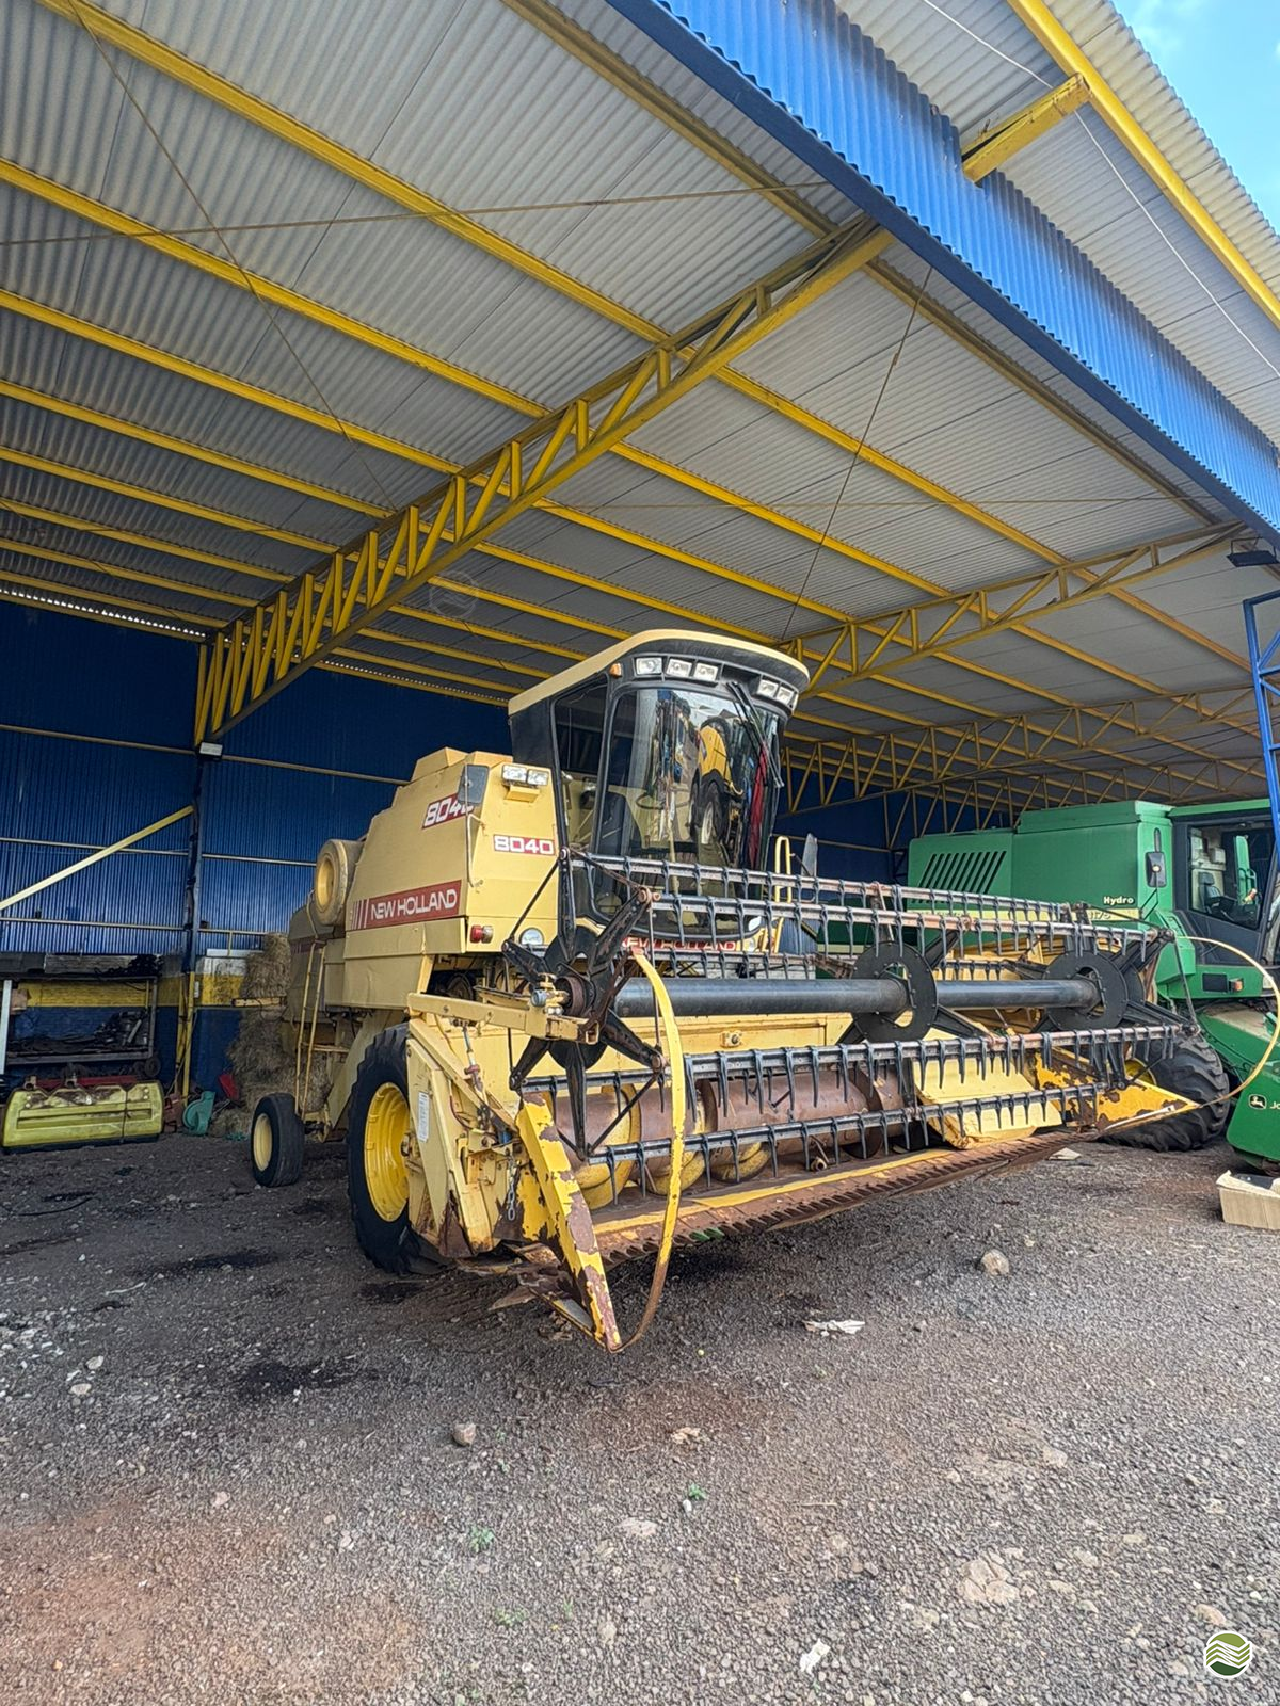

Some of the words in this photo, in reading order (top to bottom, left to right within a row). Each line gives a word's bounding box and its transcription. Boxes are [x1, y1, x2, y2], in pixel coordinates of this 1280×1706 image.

[494, 835, 554, 855] 8040
[371, 900, 396, 920] NEW
[397, 888, 458, 916] HOLLAND
[1103, 896, 1135, 906] Hydro
